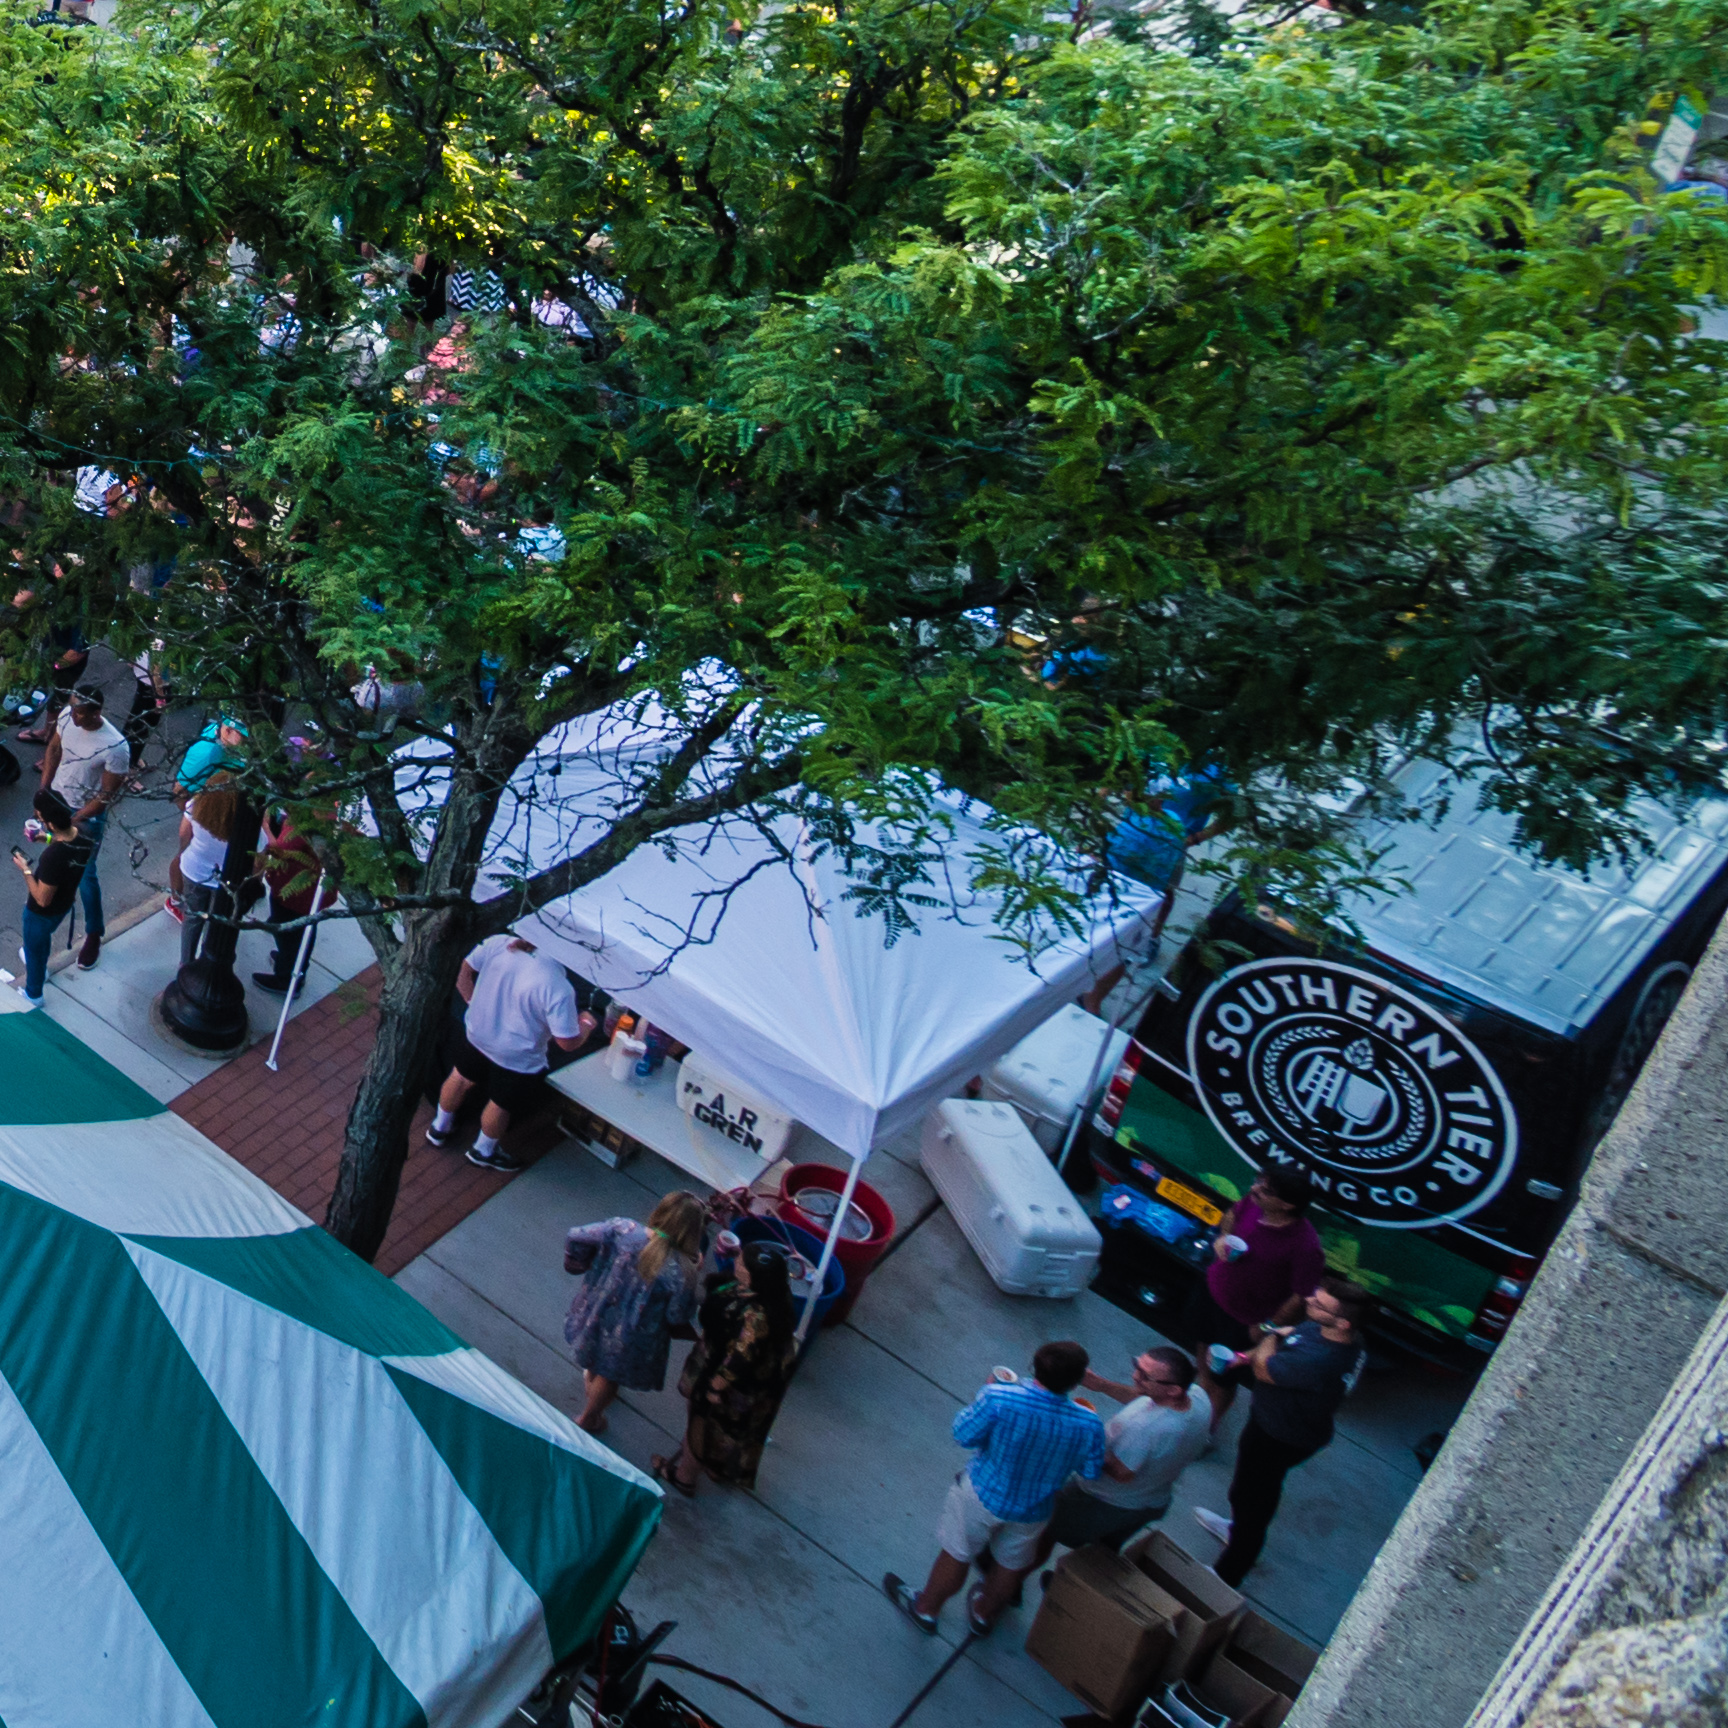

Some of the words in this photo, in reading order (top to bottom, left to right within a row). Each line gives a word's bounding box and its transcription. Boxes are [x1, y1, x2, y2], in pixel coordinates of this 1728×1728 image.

[694, 1102, 763, 1154] GREN
[1206, 974, 1461, 1069] SOUTHERN
[1432, 1085, 1493, 1185] TIER
[1220, 1092, 1358, 1201] BREWNG
